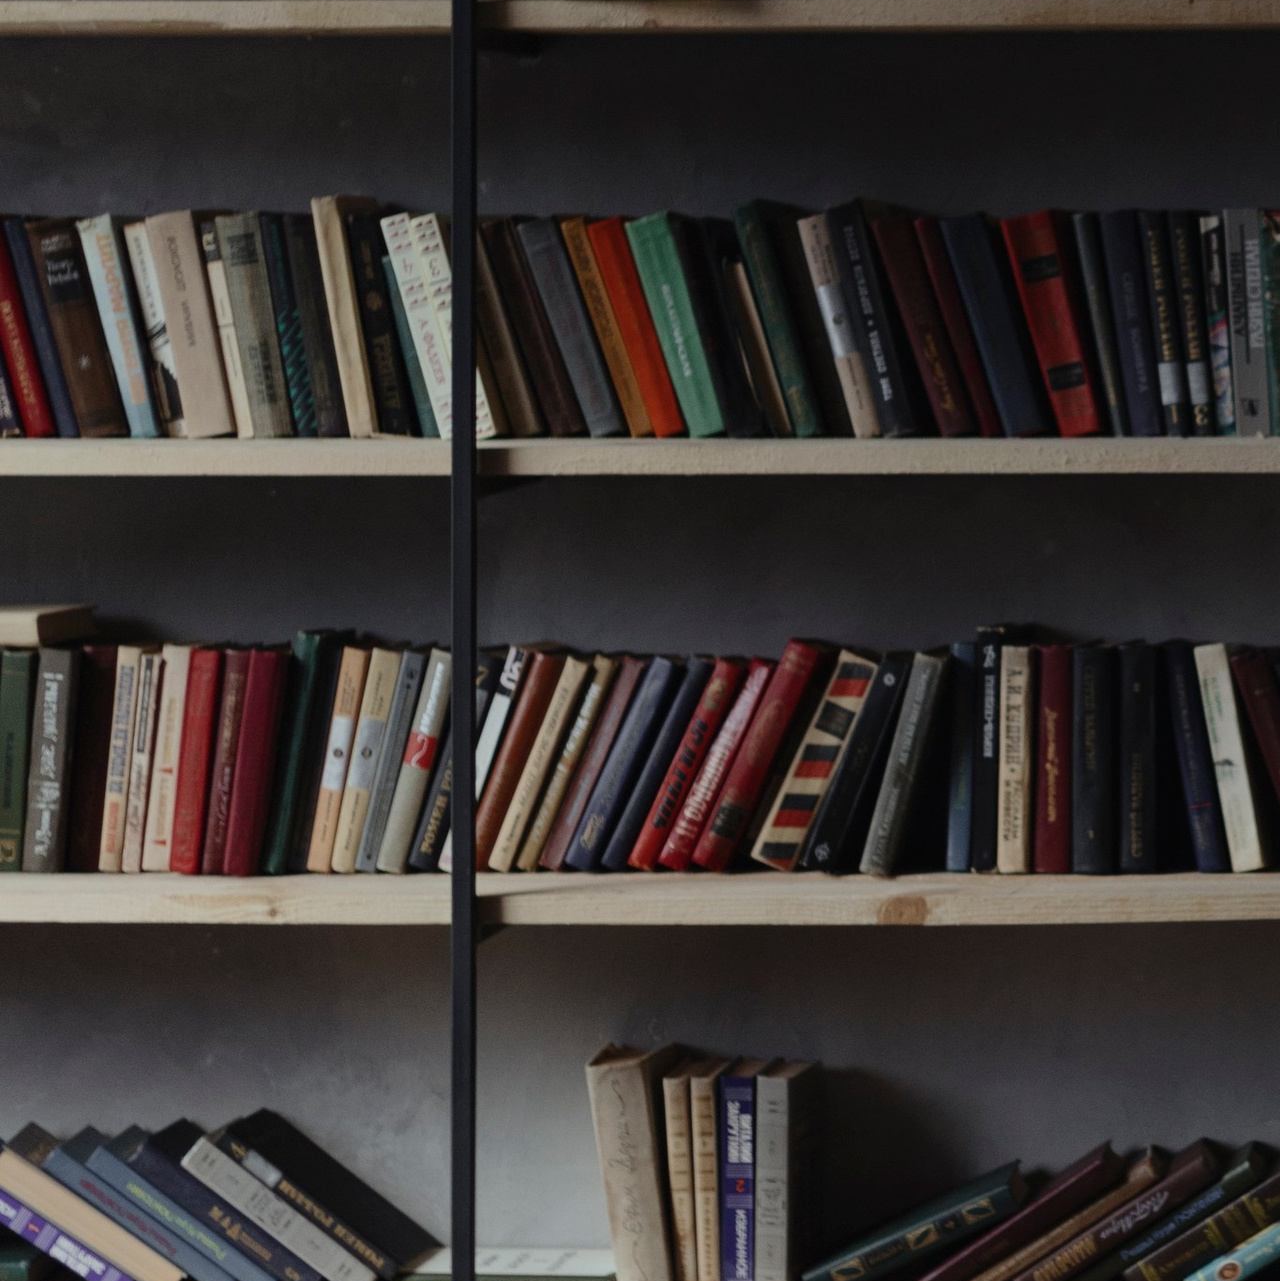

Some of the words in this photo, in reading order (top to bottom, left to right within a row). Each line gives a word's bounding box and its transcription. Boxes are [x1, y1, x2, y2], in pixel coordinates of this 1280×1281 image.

[1146, 228, 1166, 290] РОМЕН
[1171, 226, 1192, 289] РОМЕН
[1242, 238, 1264, 299] СТЕПАН
[1225, 250, 1248, 337] А.ЧАПЫГИН
[1246, 300, 1266, 347] РАЗИН
[417, 316, 446, 386] А.ФАДЕЕВ
[1155, 295, 1175, 361] РОЛЛАН
[1180, 293, 1202, 360] РОЛЛАН
[1193, 405, 1208, 426] 3
[418, 793, 449, 855] РОМЕН
[276, 1177, 335, 1231] РОЛЛАН
[734, 1177, 745, 1193] 2
[330, 1221, 386, 1272] РОМЕН
[732, 1208, 751, 1279] ИЗБРАННОЕ
